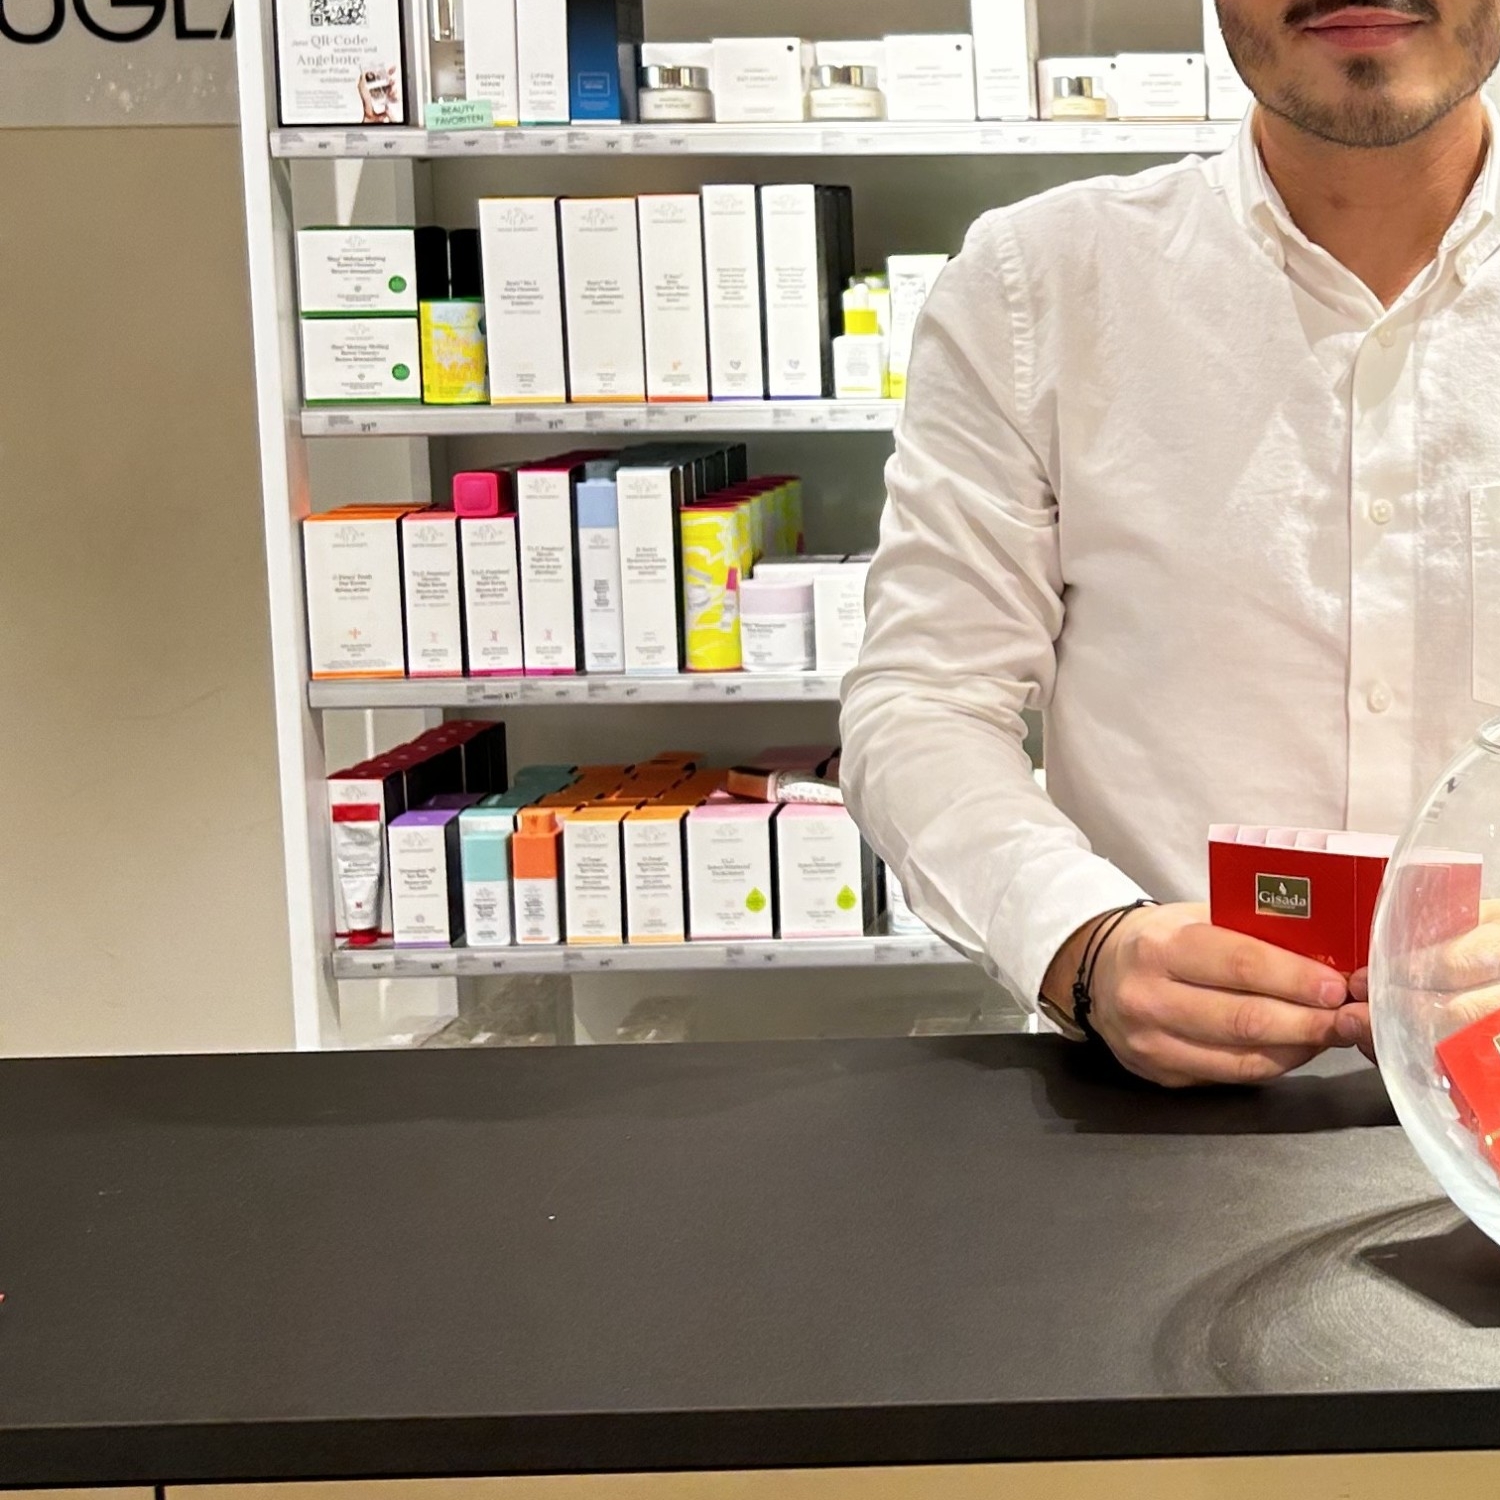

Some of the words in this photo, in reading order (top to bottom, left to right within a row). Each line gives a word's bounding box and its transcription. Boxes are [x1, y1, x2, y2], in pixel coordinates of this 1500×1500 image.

[296, 53, 360, 67] Angebote
[441, 104, 475, 115] BEAUTY
[1258, 890, 1307, 908] Gisada
